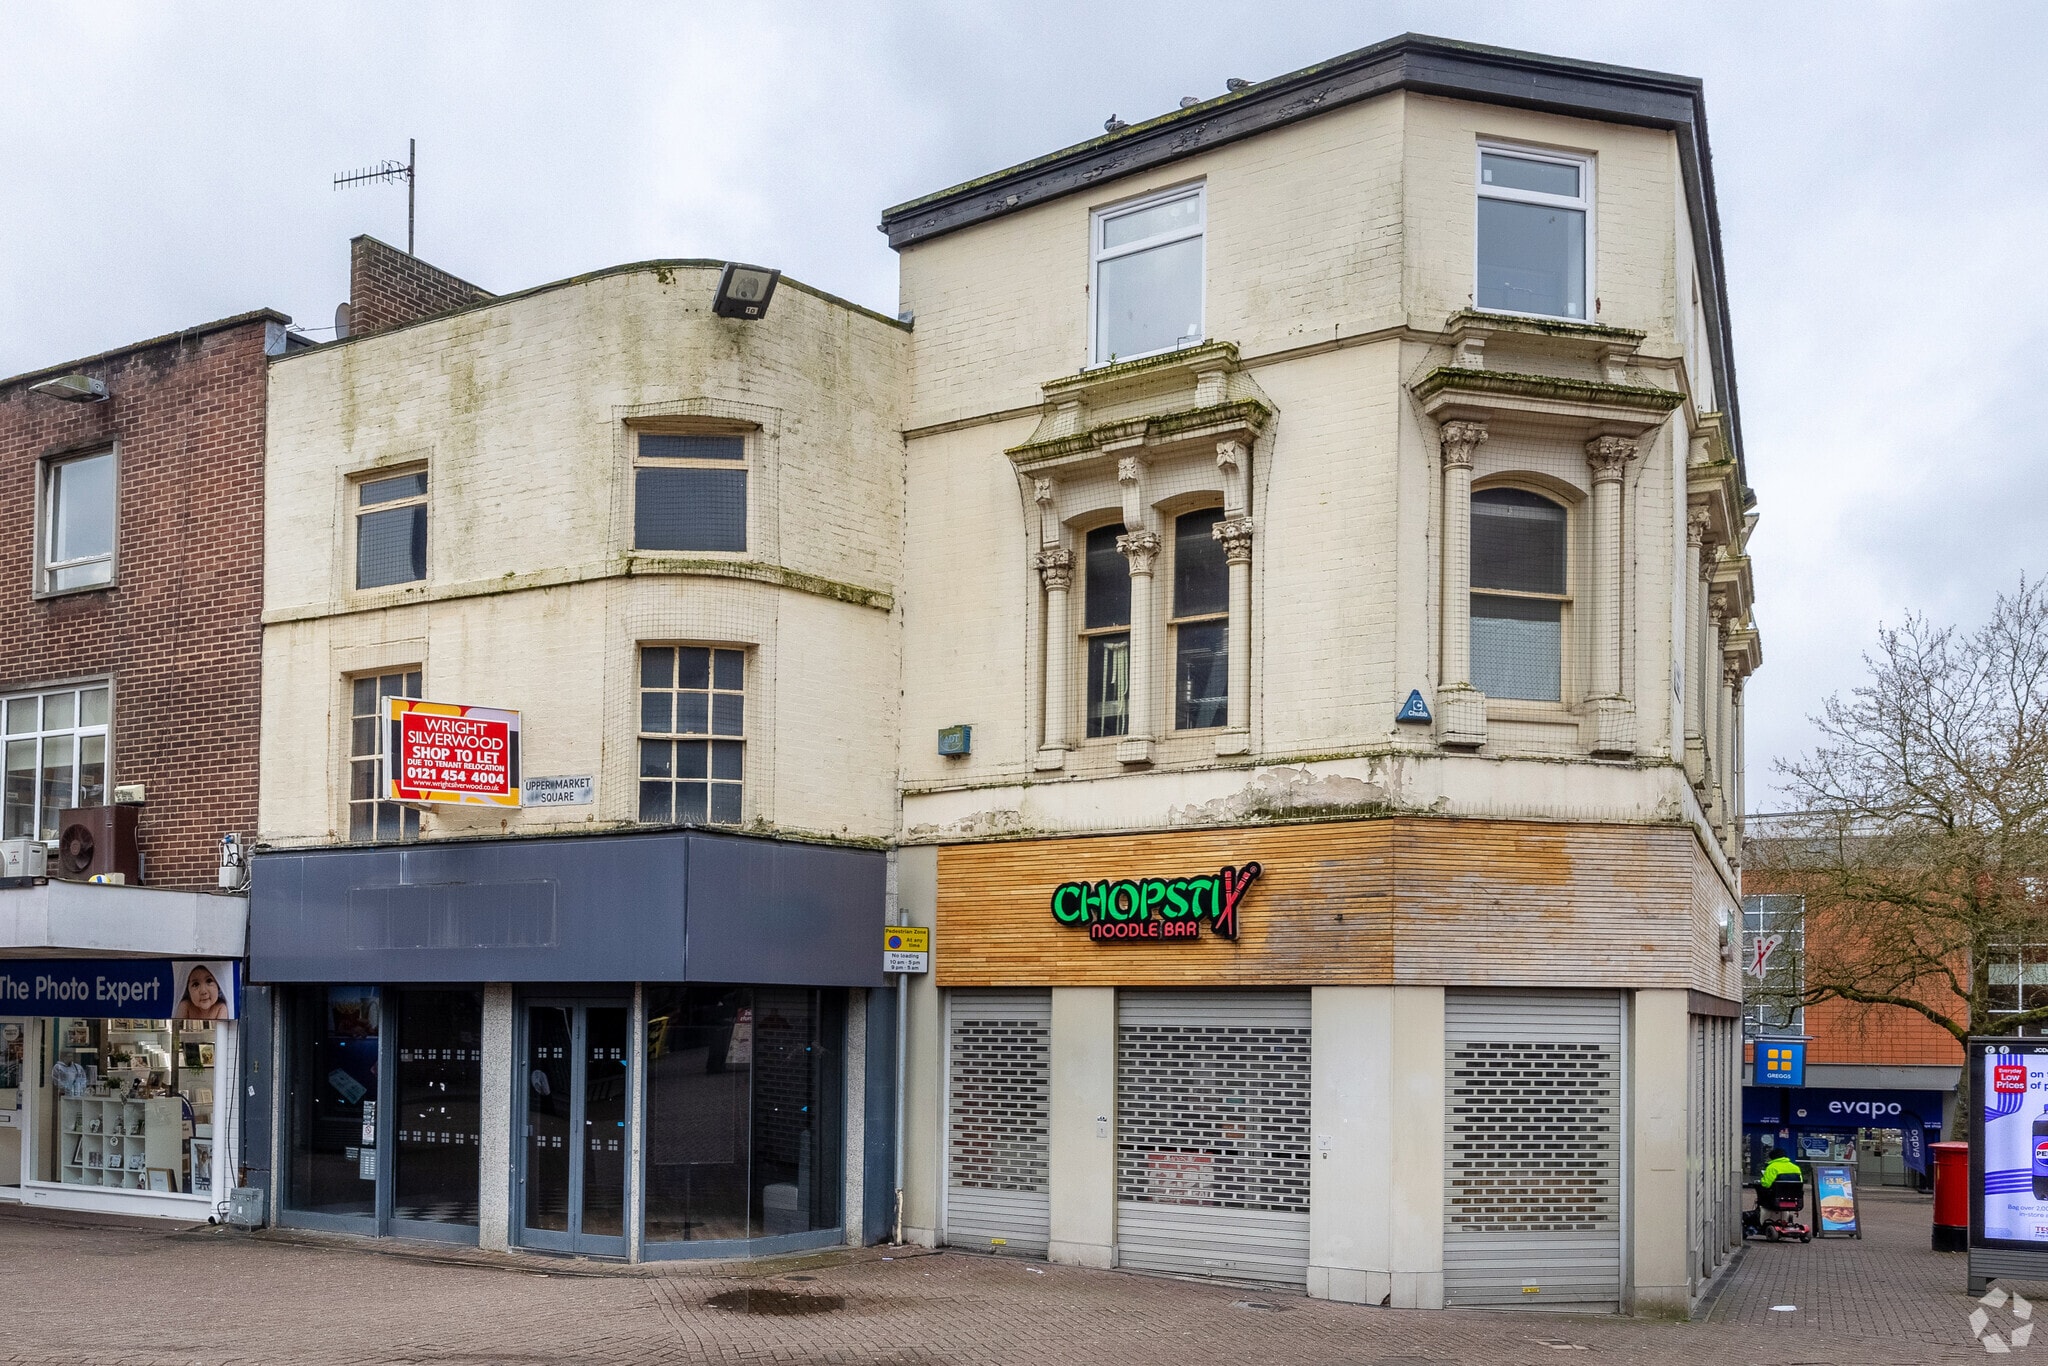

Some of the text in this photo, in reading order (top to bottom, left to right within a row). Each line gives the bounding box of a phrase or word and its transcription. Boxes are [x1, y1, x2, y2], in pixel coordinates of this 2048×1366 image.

[425, 718, 488, 735] WRIGHT
[407, 730, 503, 750] SILVERWOOD
[944, 734, 960, 742] ADT
[412, 746, 500, 764] SHOP TO LET
[407, 758, 422, 766] DUE
[435, 760, 462, 768] TENANT
[463, 763, 505, 772] RELOCATION
[407, 766, 505, 785] 0121 454 4004
[413, 780, 500, 791] www.wrightsilverwood.co.uk
[526, 778, 591, 791] UPPER MARKET
[541, 791, 574, 803] SQUARE
[1054, 871, 1250, 935] CHOPSTIX
[1091, 921, 1197, 938] NOODLE BAR
[0, 974, 160, 1008] The Photo Expert
[1996, 1081, 2025, 1089] Prices
[2000, 1073, 2020, 1081] Low
[1828, 1101, 1902, 1120] evapo
[1910, 1129, 1920, 1158] evapo
